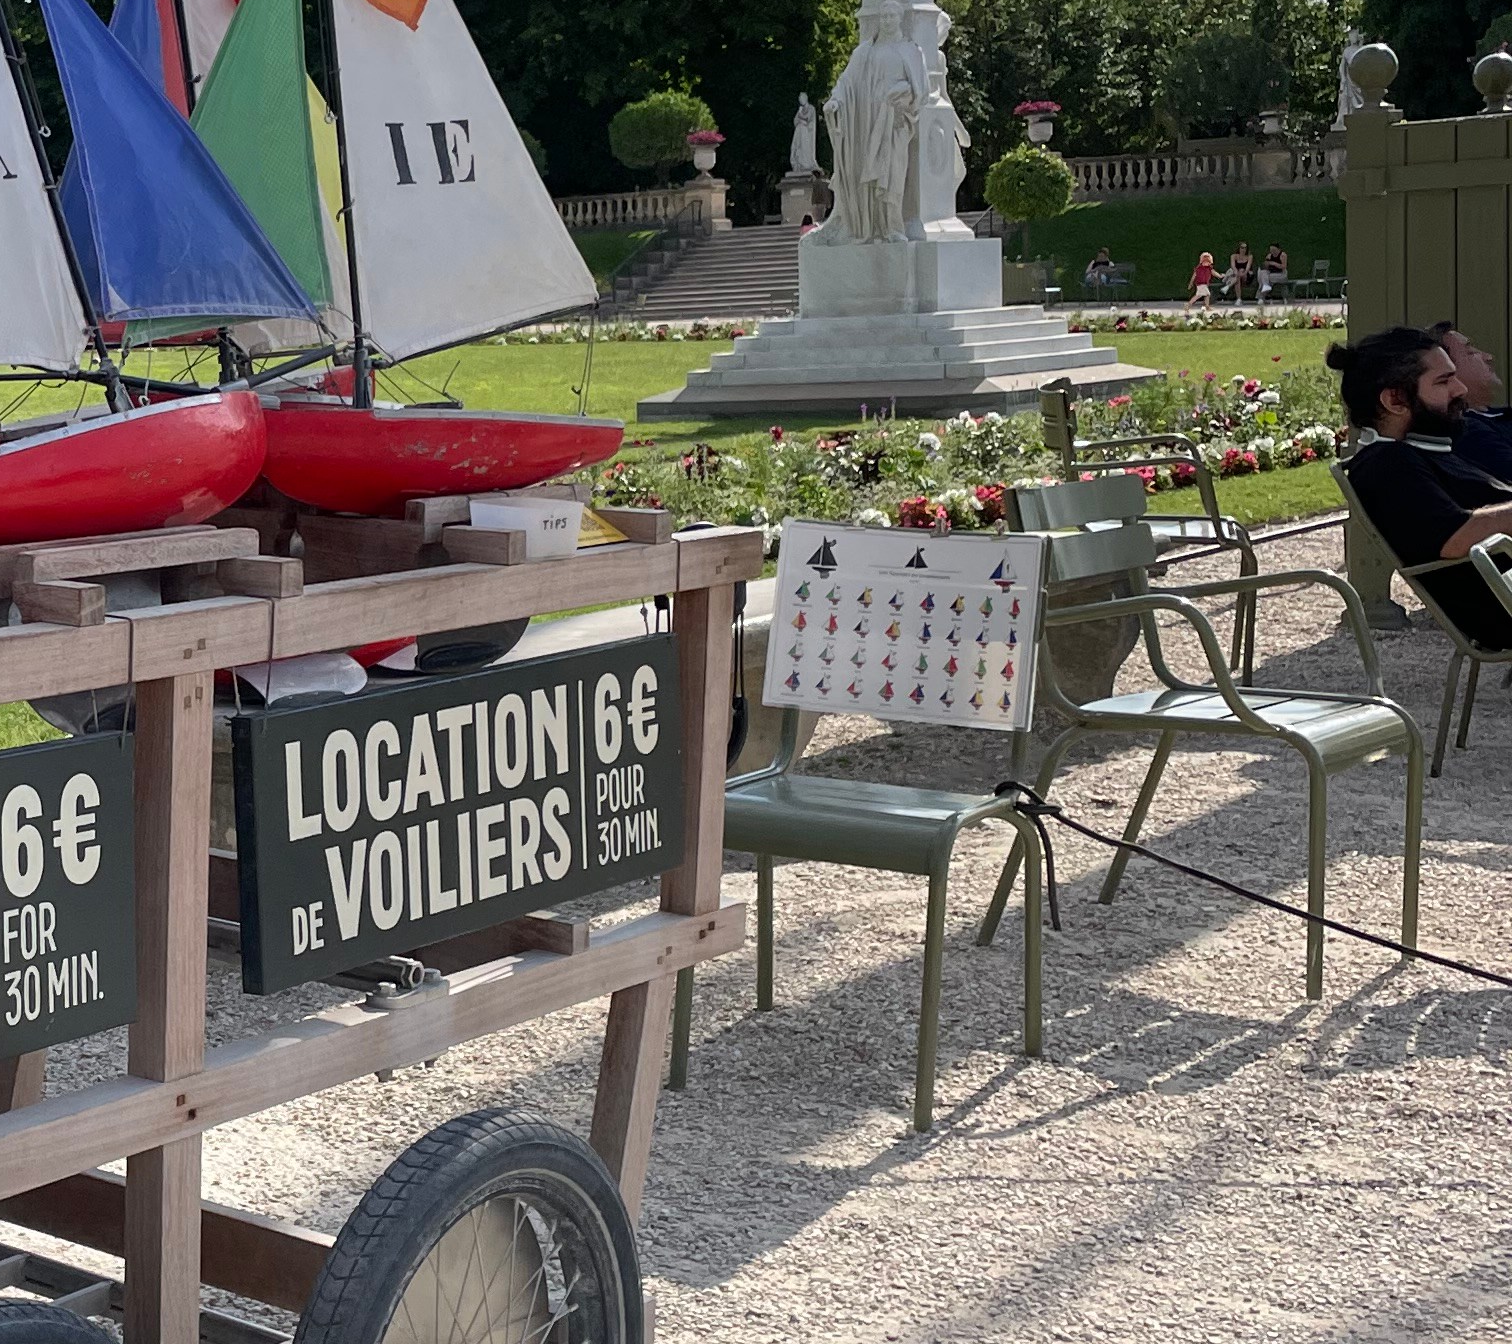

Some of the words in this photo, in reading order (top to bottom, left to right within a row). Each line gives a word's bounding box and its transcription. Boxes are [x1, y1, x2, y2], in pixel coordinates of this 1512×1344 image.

[385, 120, 475, 185] IE
[285, 685, 568, 841] LOCATION
[597, 764, 644, 815] POUR
[598, 818, 621, 865] 30
[625, 808, 662, 856] MIN.
[293, 901, 324, 955] DE
[325, 788, 571, 940] VOILIERS
[4, 902, 56, 963] FOR
[5, 966, 40, 1025] 30
[48, 951, 104, 1013] MIN.
